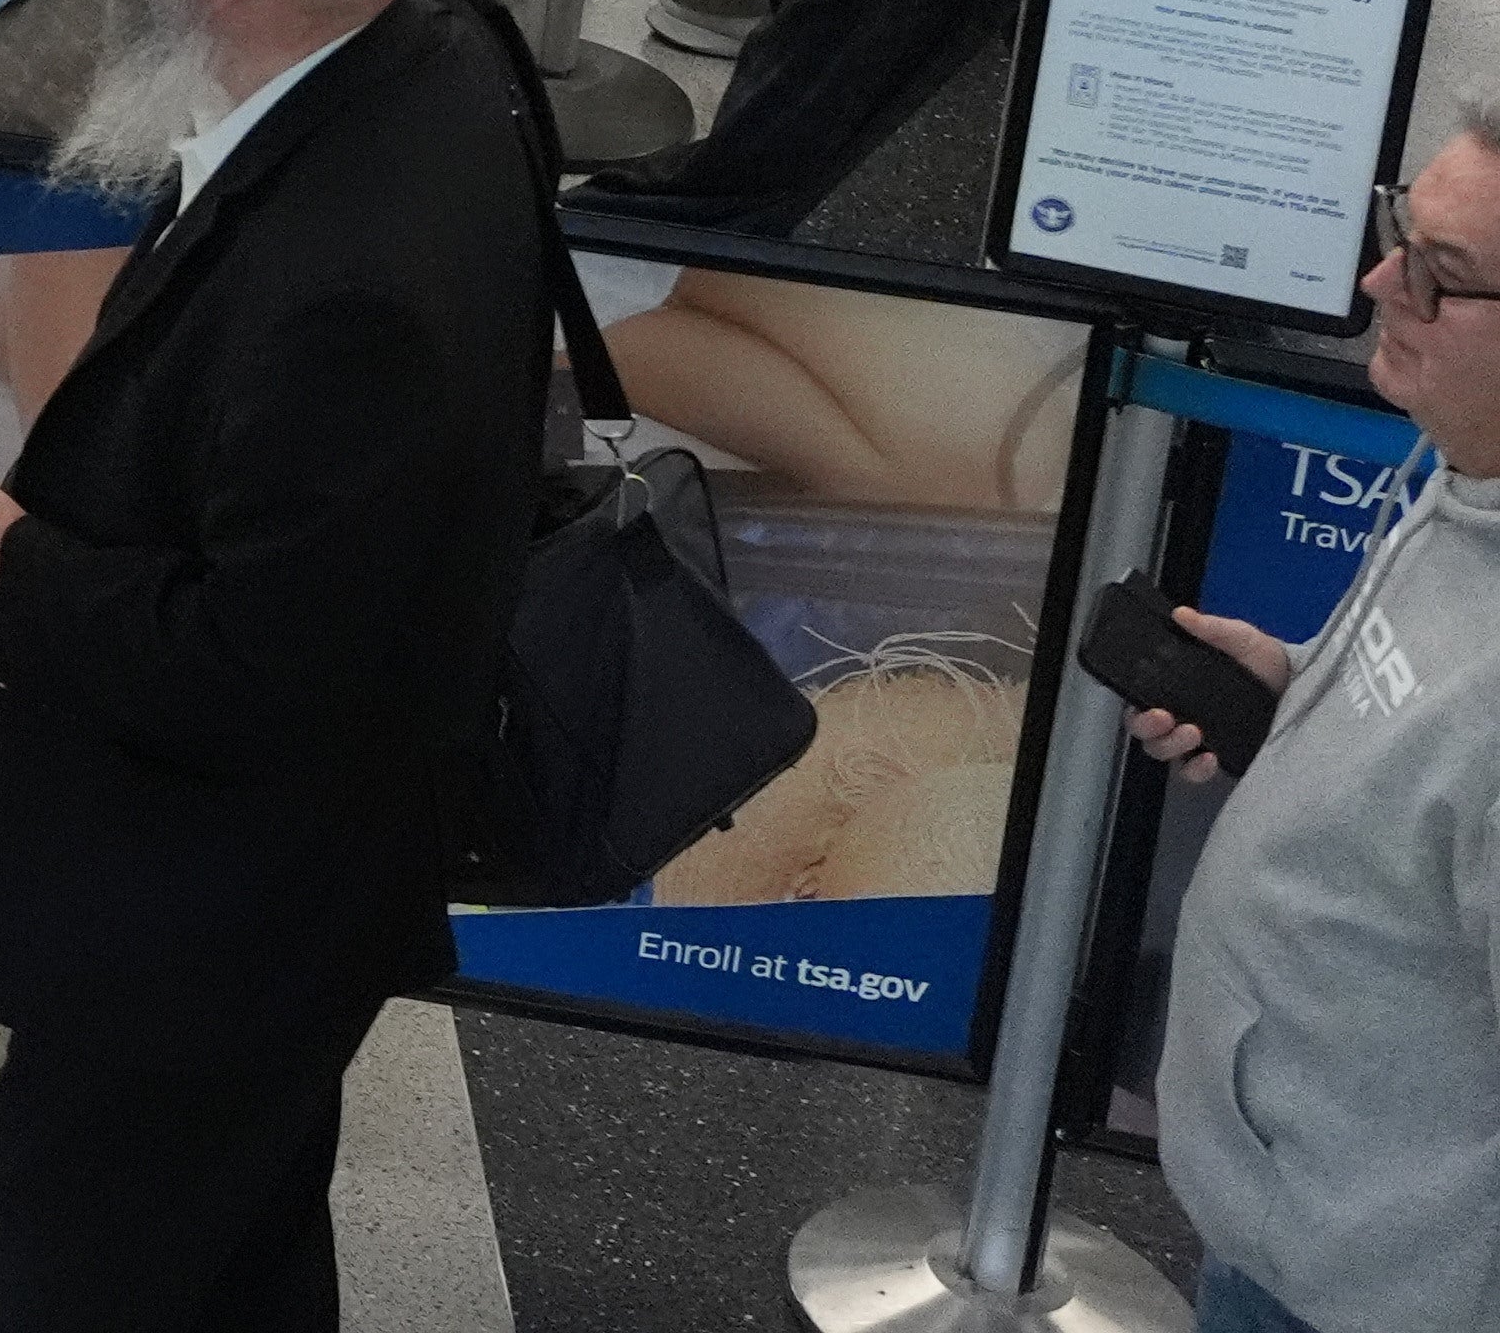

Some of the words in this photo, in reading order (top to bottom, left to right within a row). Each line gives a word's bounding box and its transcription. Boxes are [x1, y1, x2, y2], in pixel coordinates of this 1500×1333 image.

[638, 932, 742, 976] Enroll
[750, 952, 788, 984] at
[796, 955, 929, 1006] tsa.gov
